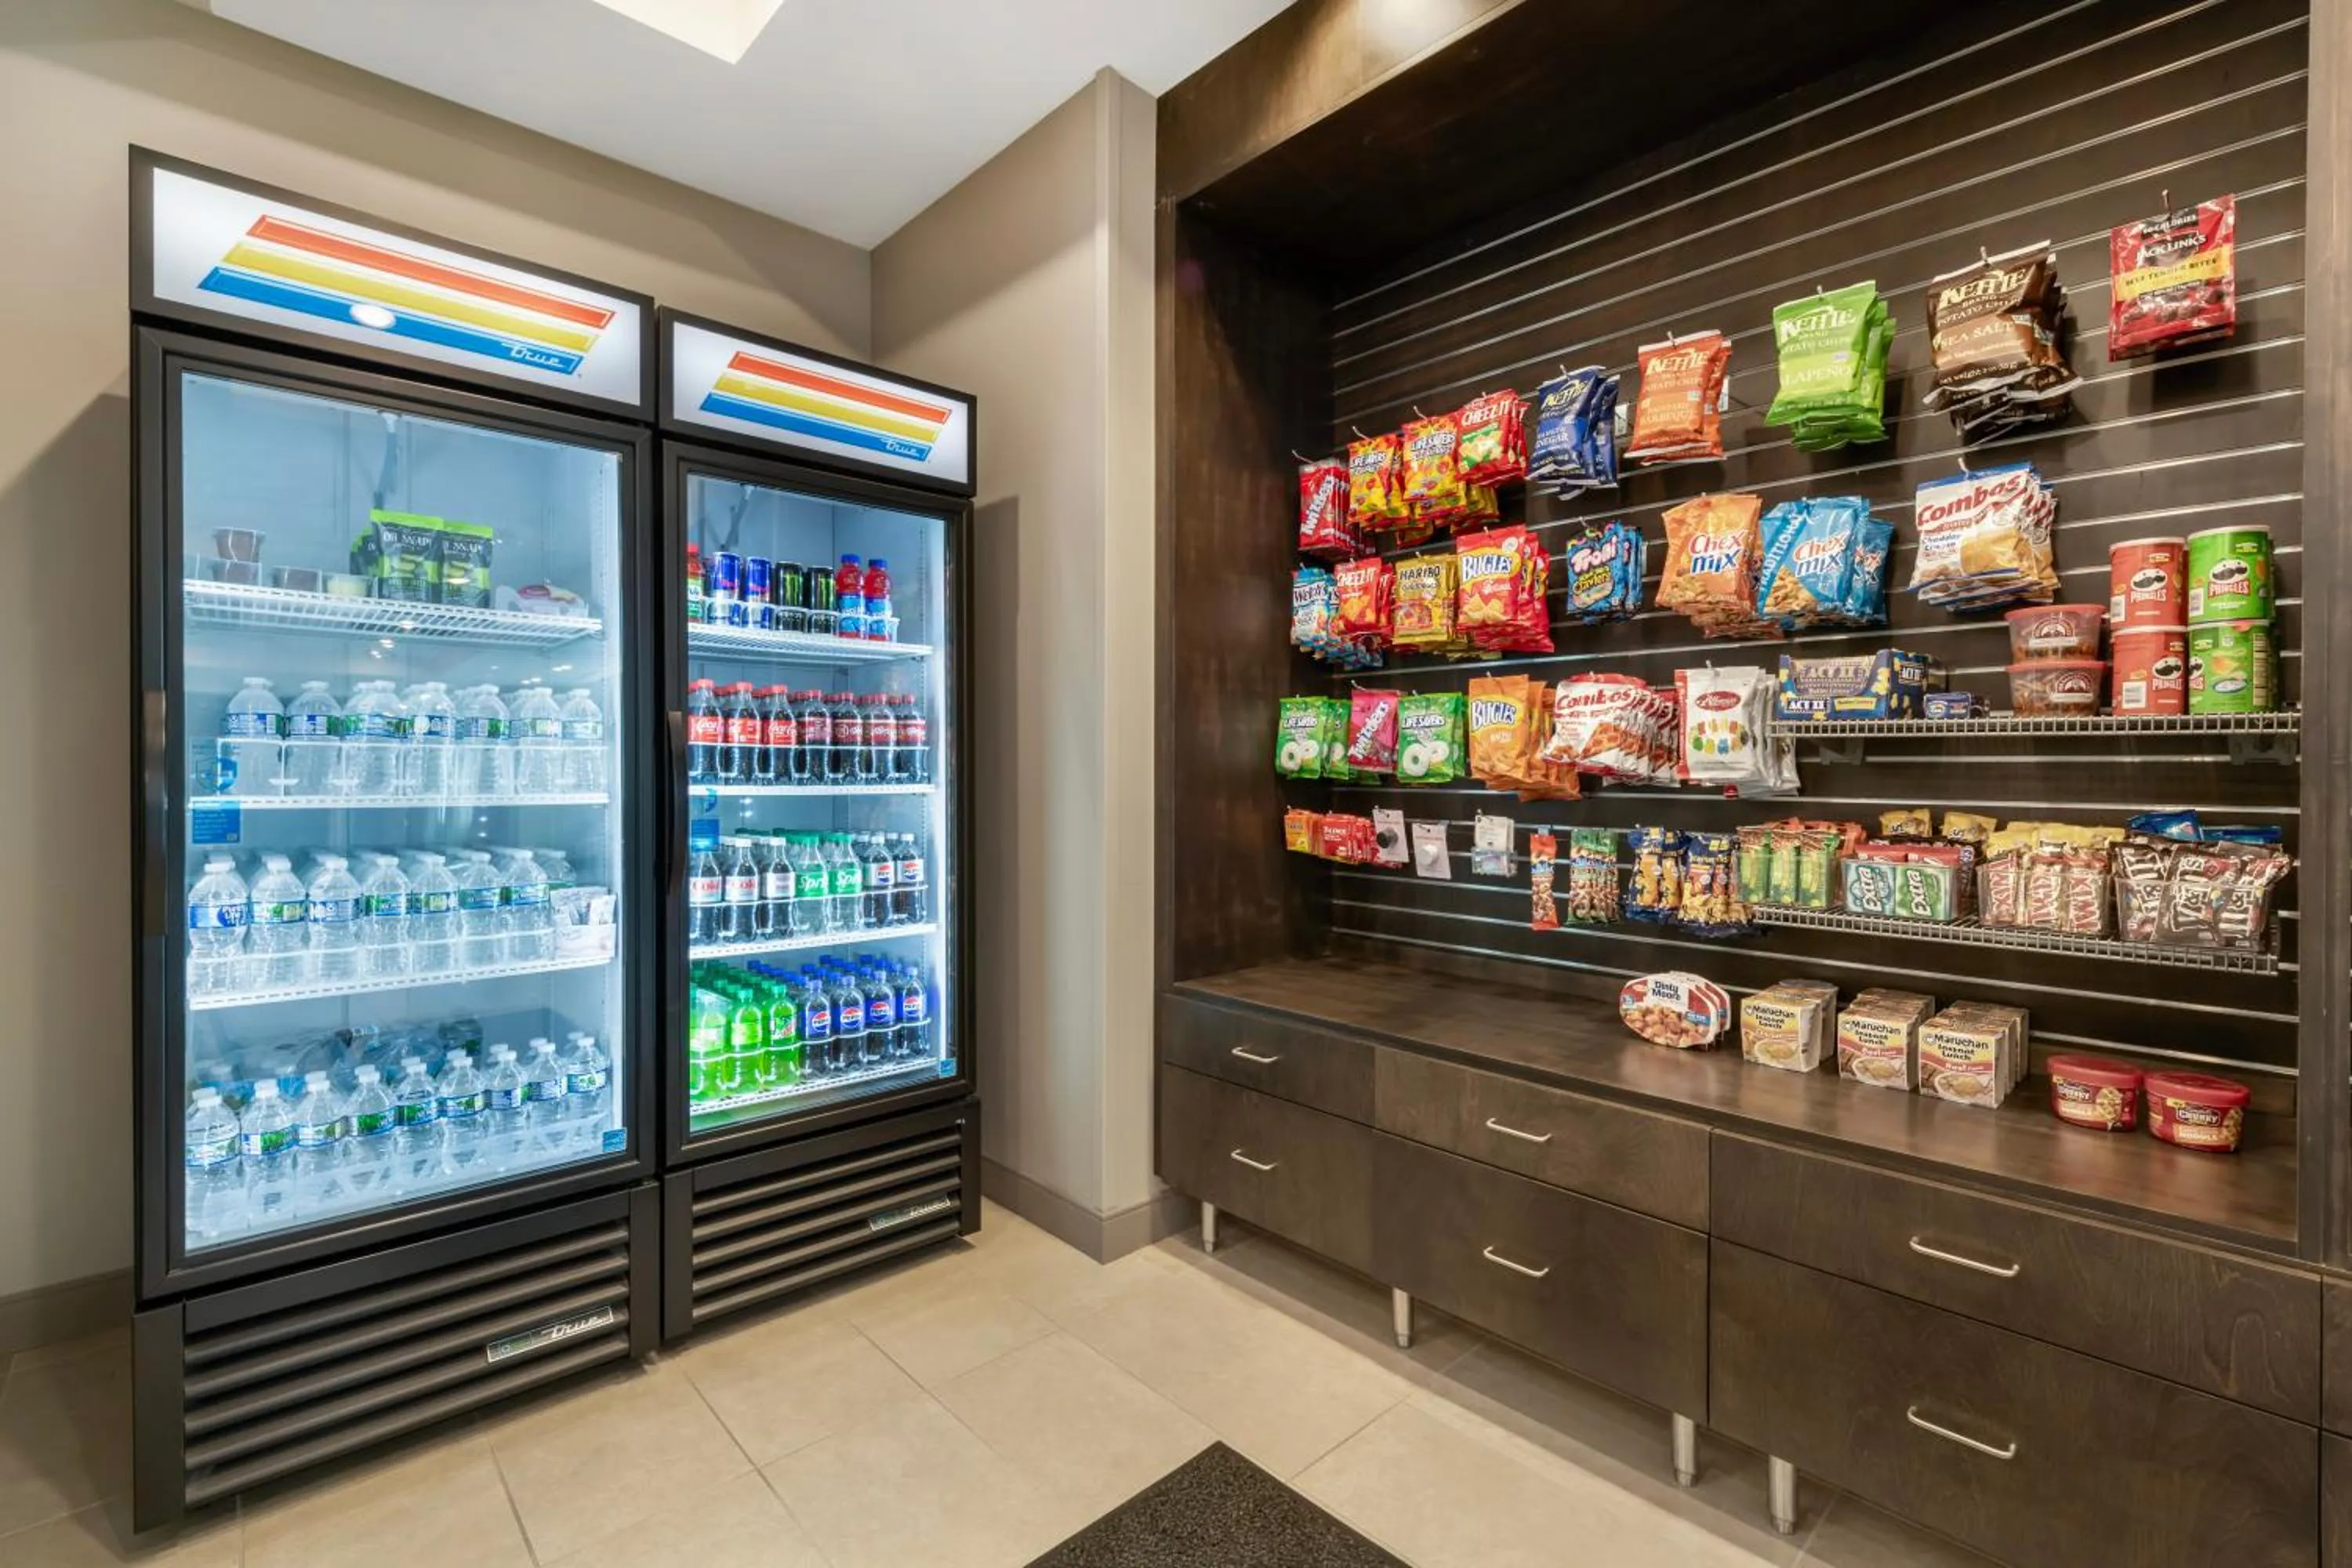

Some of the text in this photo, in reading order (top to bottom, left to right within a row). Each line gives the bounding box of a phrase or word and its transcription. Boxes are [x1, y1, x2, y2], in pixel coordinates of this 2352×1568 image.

[502, 342, 564, 368] True
[1918, 474, 2022, 527] Combos
[1690, 528, 1748, 556] Chex
[1793, 530, 1850, 561] Chex
[1570, 535, 1617, 573] Trolli
[1399, 565, 1441, 581] HARIBO
[1462, 554, 1512, 584] BUGLES
[2209, 581, 2249, 598] PRINGLES
[1555, 688, 1632, 711] Combos
[1472, 699, 1516, 731] BUGLES
[1652, 988, 1681, 1001] Moore
[1654, 981, 1679, 993] Dinty
[1753, 1005, 1795, 1018] Maruchan
[1851, 1020, 1901, 1036] Maruchan
[1934, 1033, 1990, 1050] Maruchan
[540, 1316, 609, 1339] True
